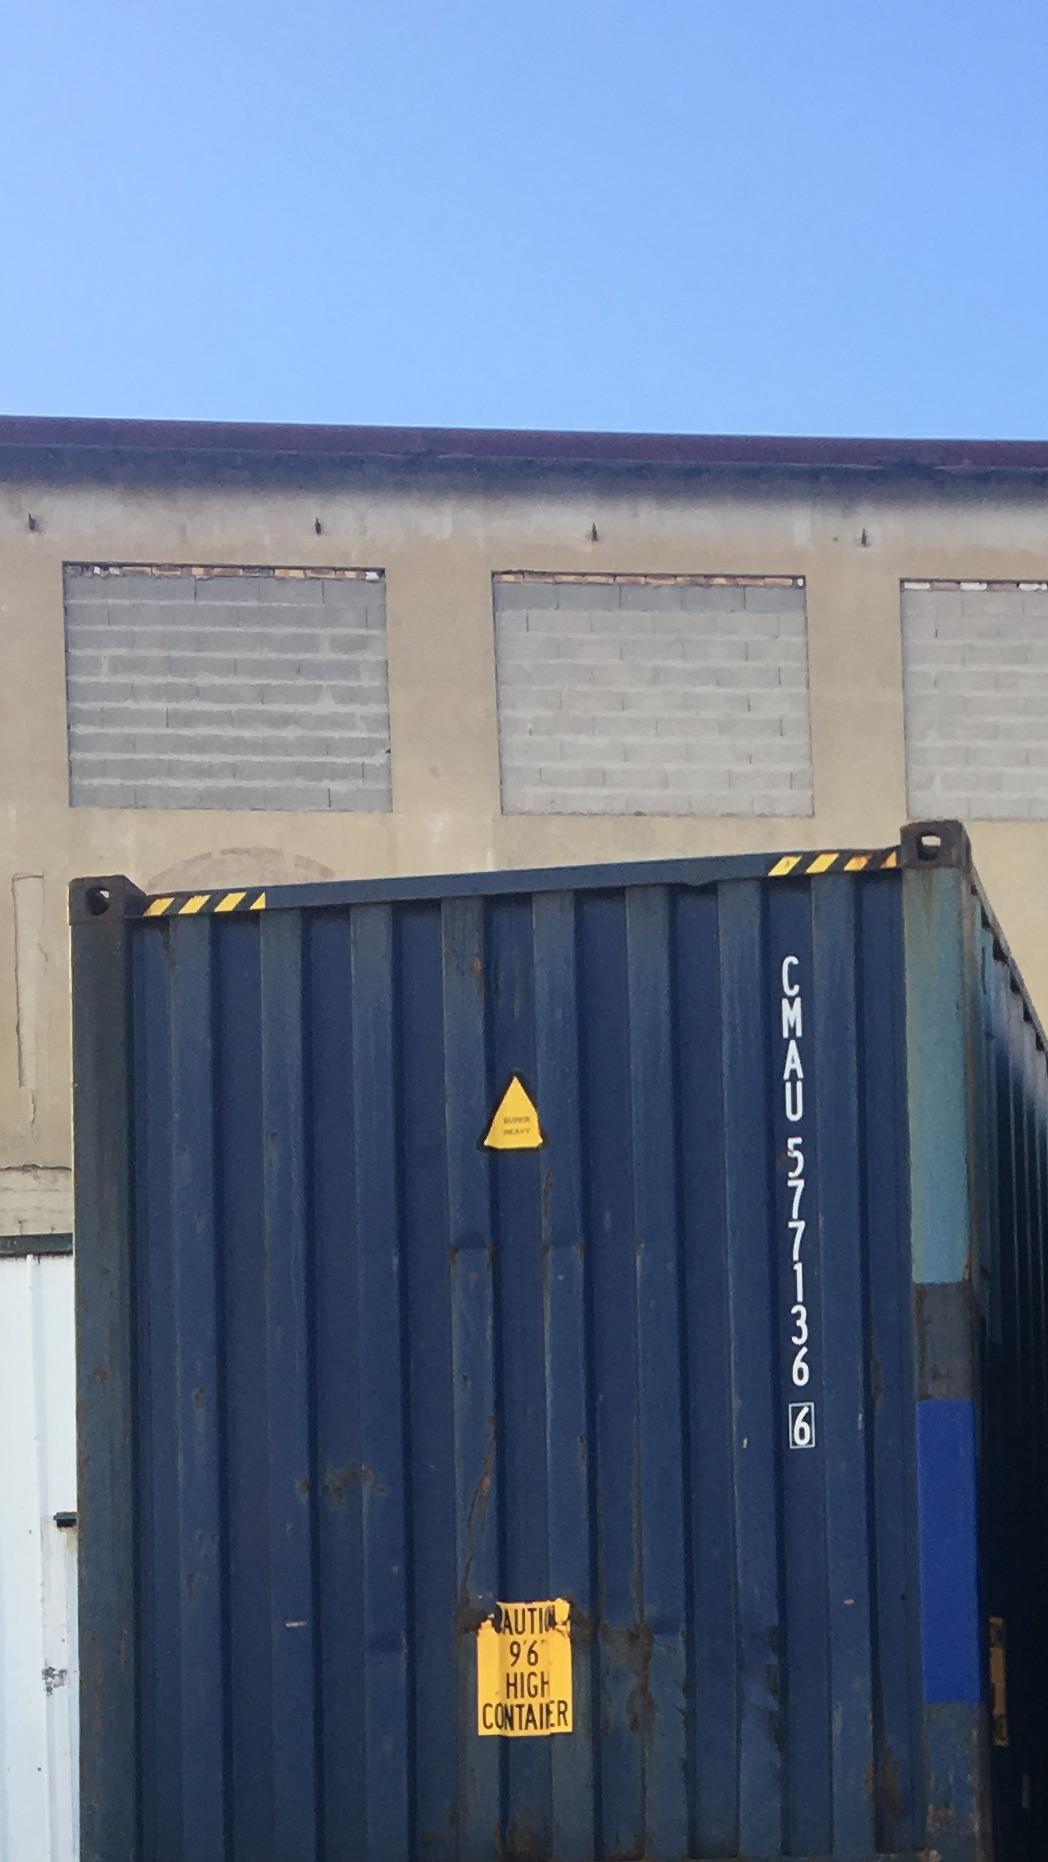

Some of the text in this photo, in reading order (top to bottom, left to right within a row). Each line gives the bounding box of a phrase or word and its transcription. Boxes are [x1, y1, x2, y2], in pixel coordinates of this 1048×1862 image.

[781, 956, 811, 1446] CMAU 577136 6
[506, 1671, 550, 1699] HIGH
